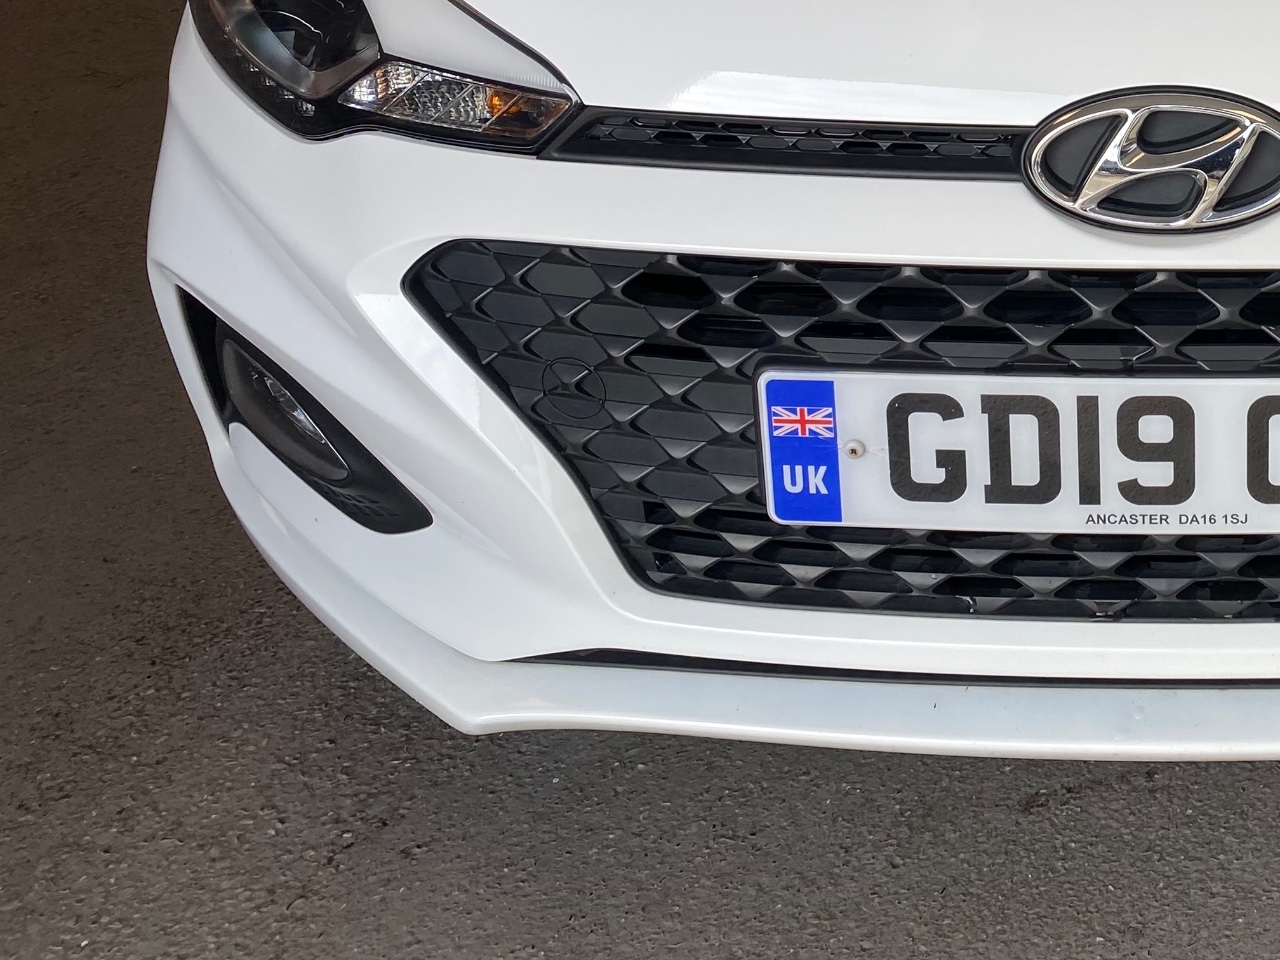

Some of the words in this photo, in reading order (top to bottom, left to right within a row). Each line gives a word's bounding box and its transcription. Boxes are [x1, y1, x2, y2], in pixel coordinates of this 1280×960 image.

[886, 392, 1196, 506] GD19
[782, 464, 829, 496] UK
[1085, 513, 1170, 525] ANCASTER
[1178, 513, 1217, 525] DA16
[1221, 513, 1248, 525] 1SJ
